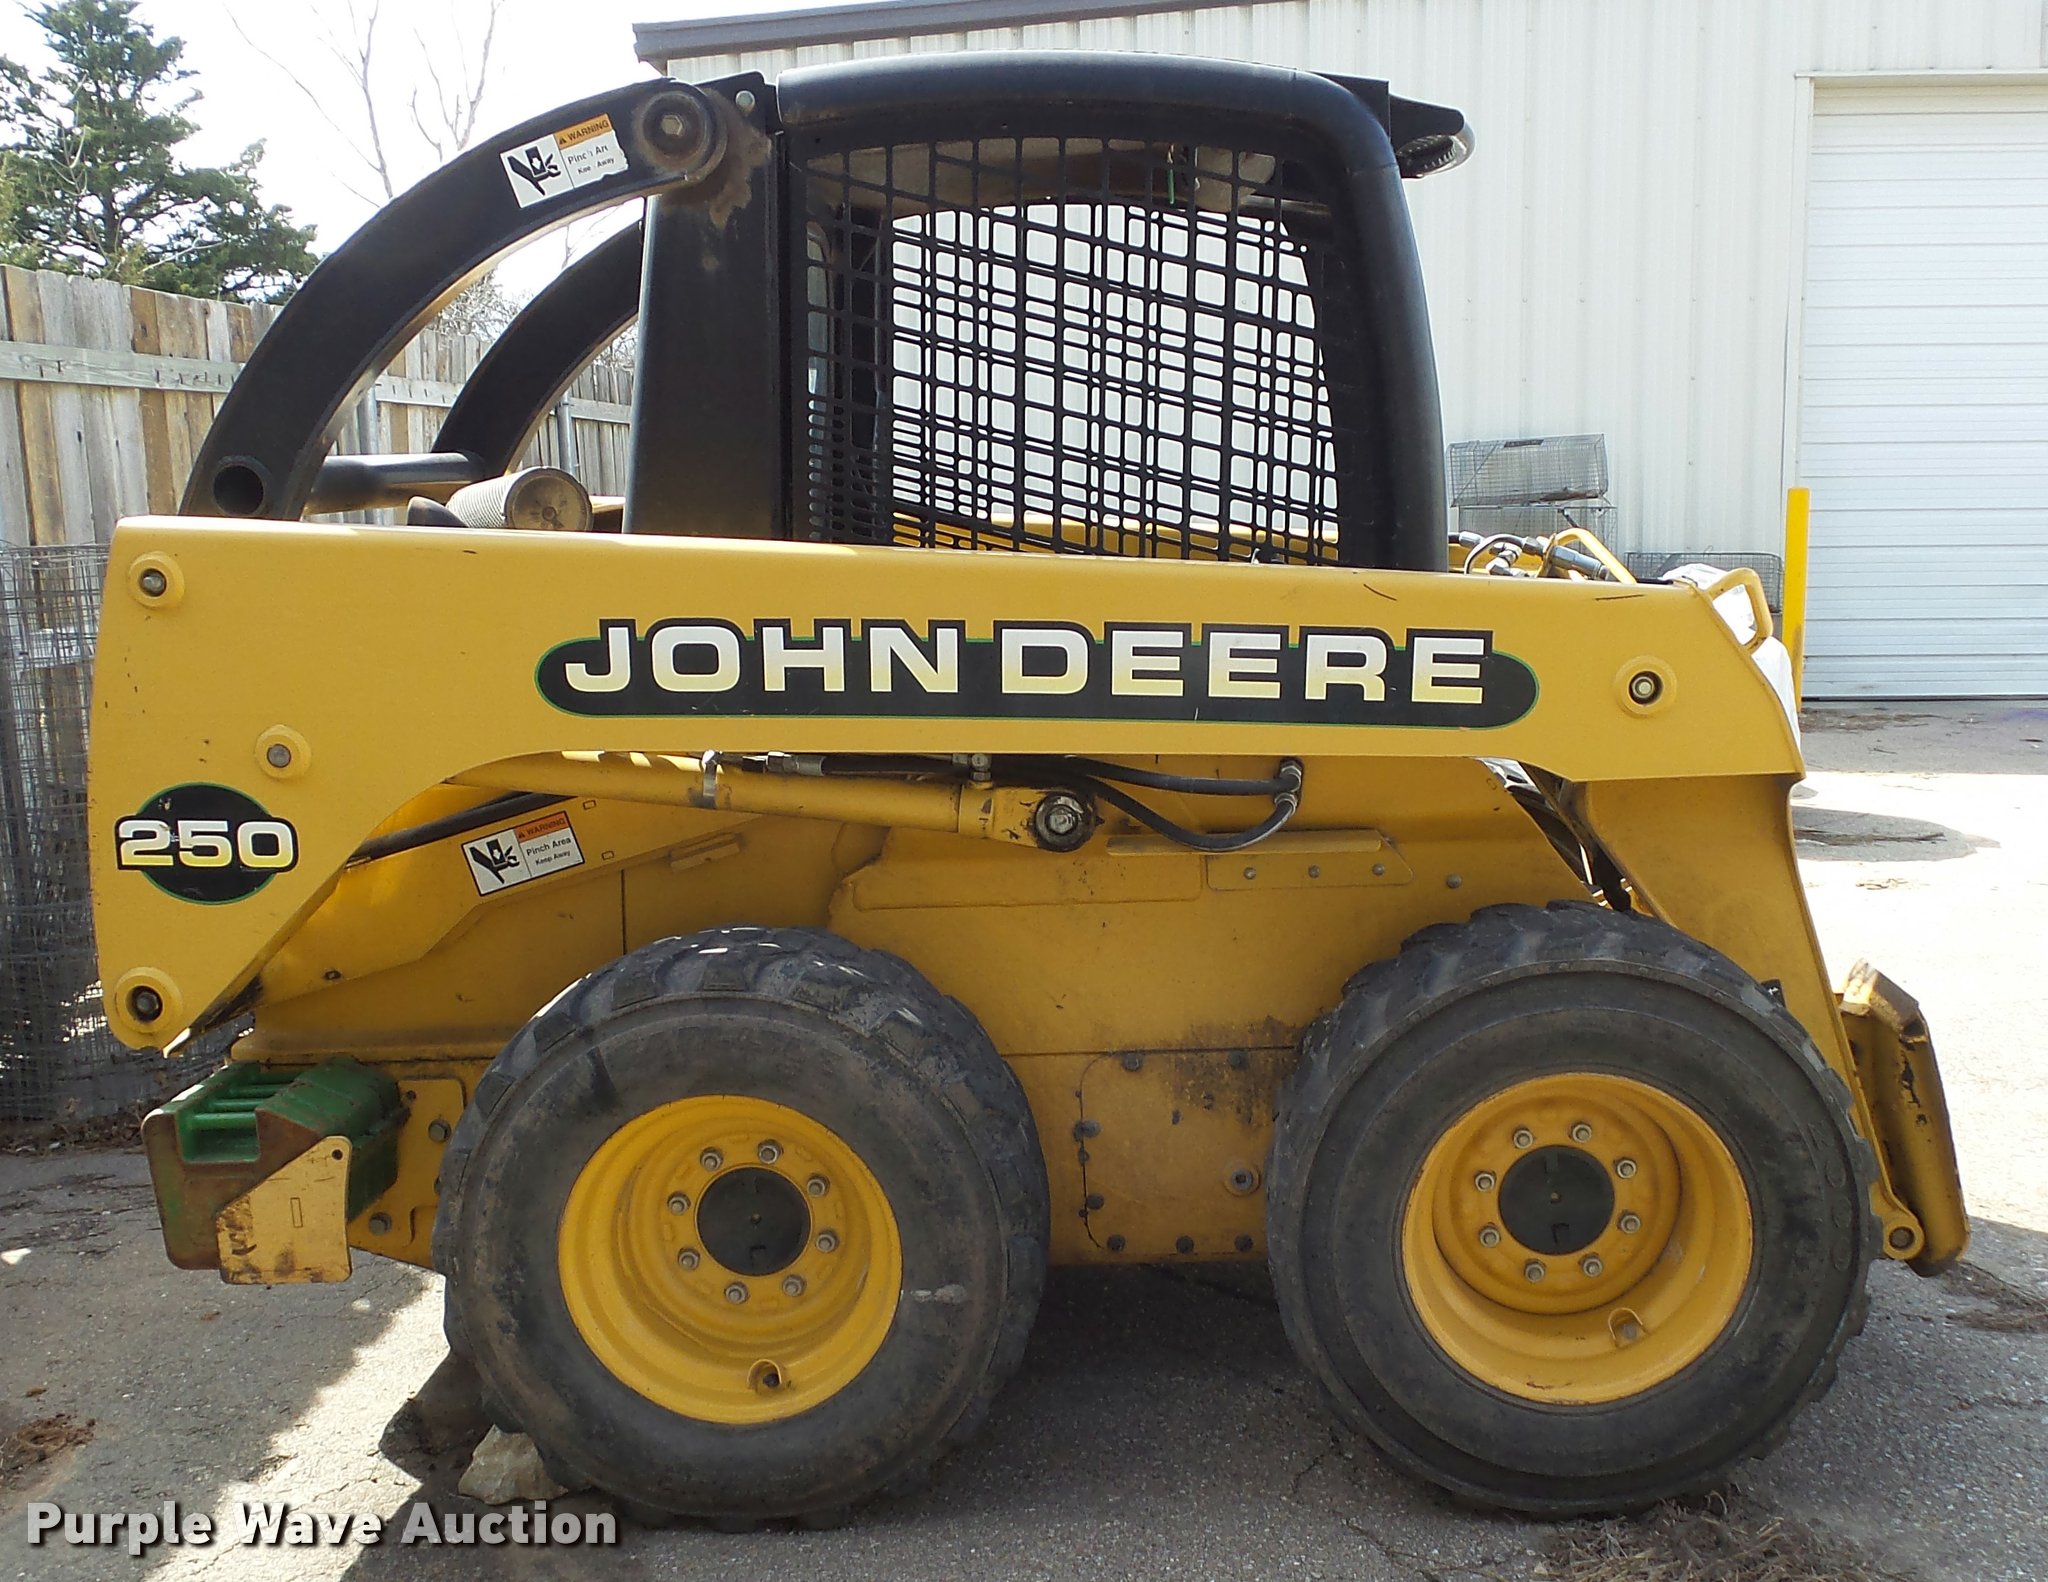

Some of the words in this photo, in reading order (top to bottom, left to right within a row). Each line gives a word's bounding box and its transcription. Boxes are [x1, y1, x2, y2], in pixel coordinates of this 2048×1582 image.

[568, 120, 608, 141] WARNING
[597, 157, 614, 167] Away
[565, 626, 959, 693] JOHN
[1001, 627, 1485, 704] DEERE
[527, 818, 565, 834] WARNING
[118, 820, 294, 868] 250
[526, 843, 550, 856] Pinch
[552, 837, 571, 848] Area
[535, 856, 552, 865] Keep
[553, 850, 571, 859] Away
